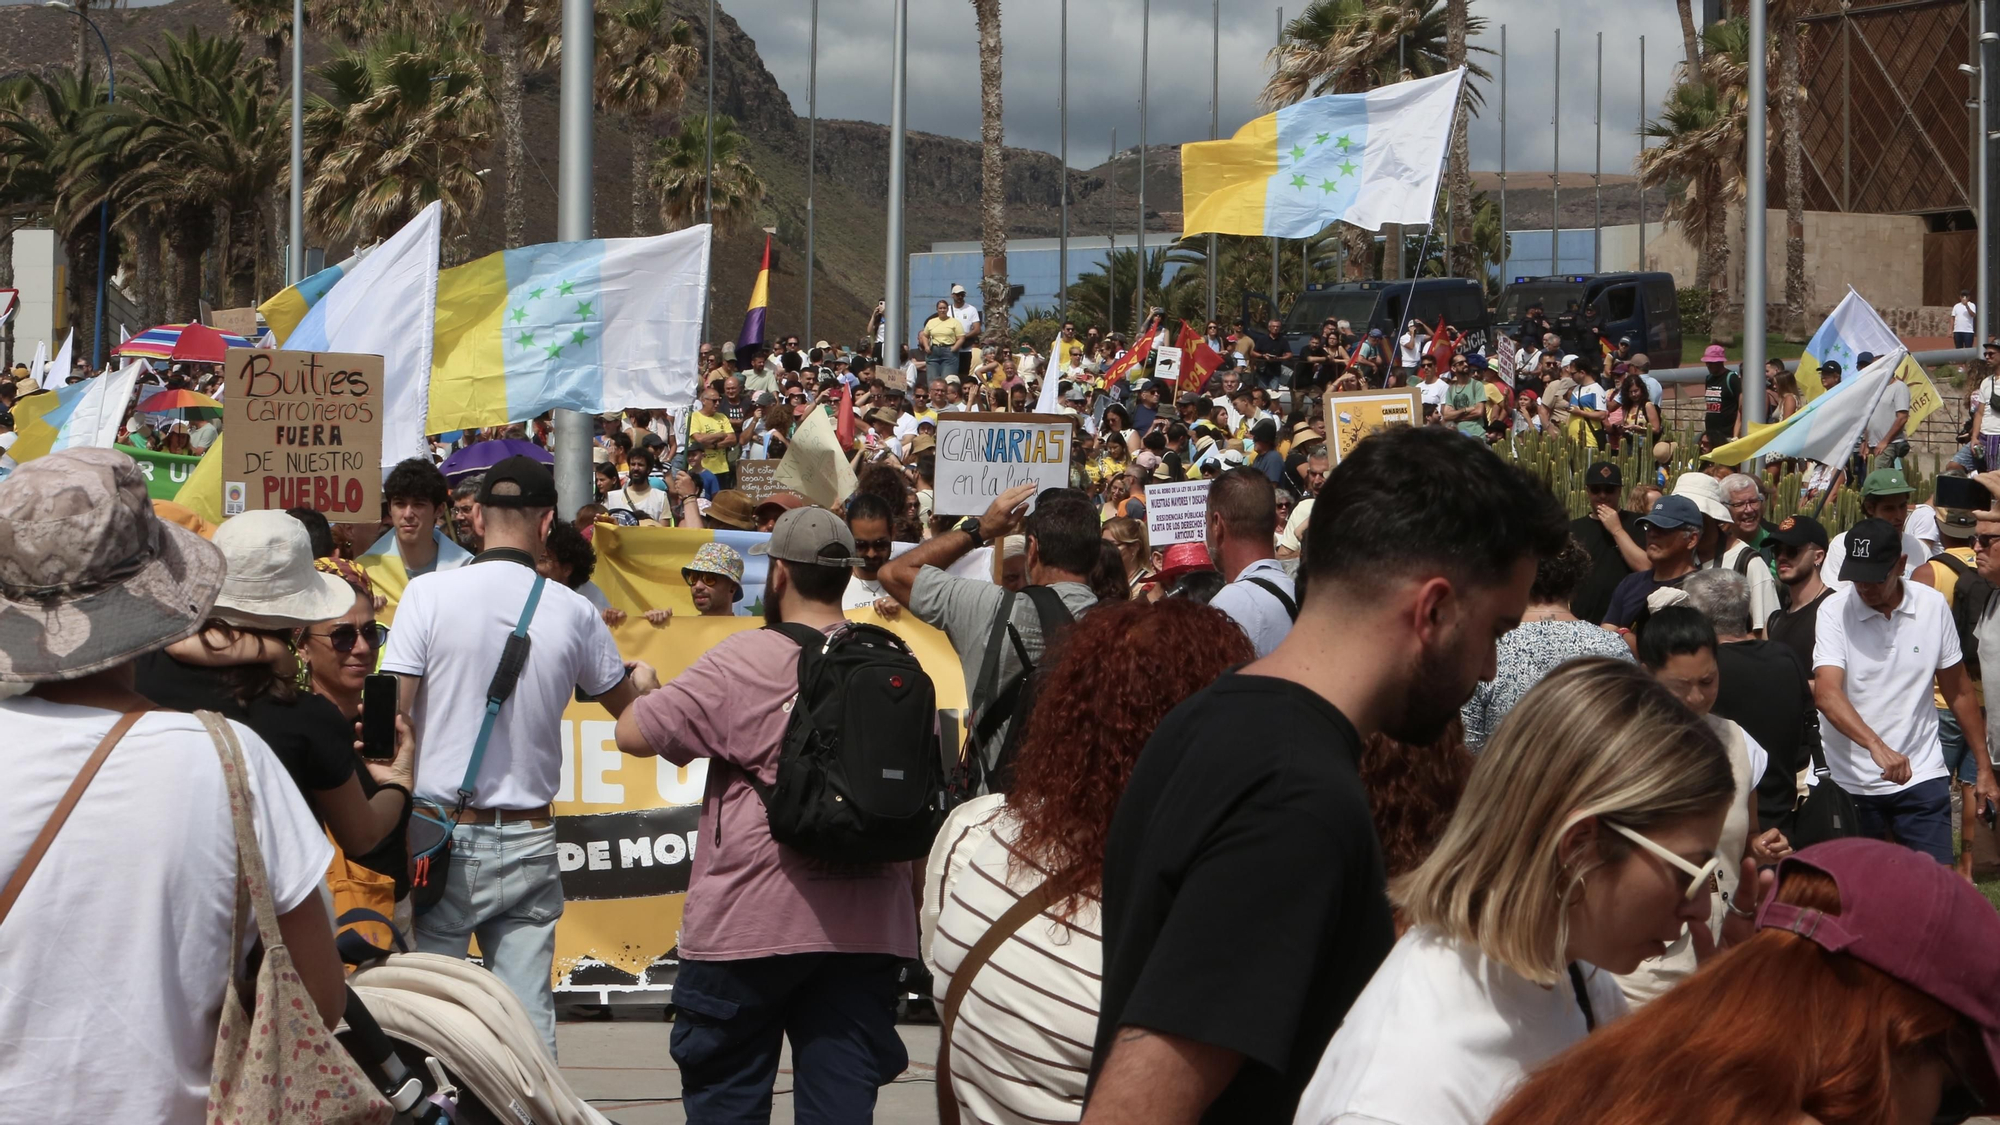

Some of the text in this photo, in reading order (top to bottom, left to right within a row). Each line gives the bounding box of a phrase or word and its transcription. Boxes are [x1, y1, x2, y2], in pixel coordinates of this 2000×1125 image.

[1455, 329, 1487, 355] OLICIA
[240, 353, 373, 397] Buitres
[246, 397, 374, 423] Carroñeros
[276, 424, 343, 446] FUERA
[942, 428, 1065, 463] CANARIAS
[137, 461, 154, 481] R
[243, 451, 364, 474] DE NUESTRO
[741, 483, 761, 493] estoy
[952, 474, 974, 495] en
[981, 465, 999, 495] la
[263, 475, 364, 513] PUEBLO
[1171, 496, 1188, 506] MAYORES
[1151, 523, 1166, 532] CARTA
[1166, 522, 1172, 530] DE
[1181, 520, 1203, 529] DERECHOS
[1156, 513, 1183, 521] RESIDENCIAS
[1197, 529, 1203, 538] 25
[1852, 538, 1870, 558] M
[556, 840, 612, 872] DE
